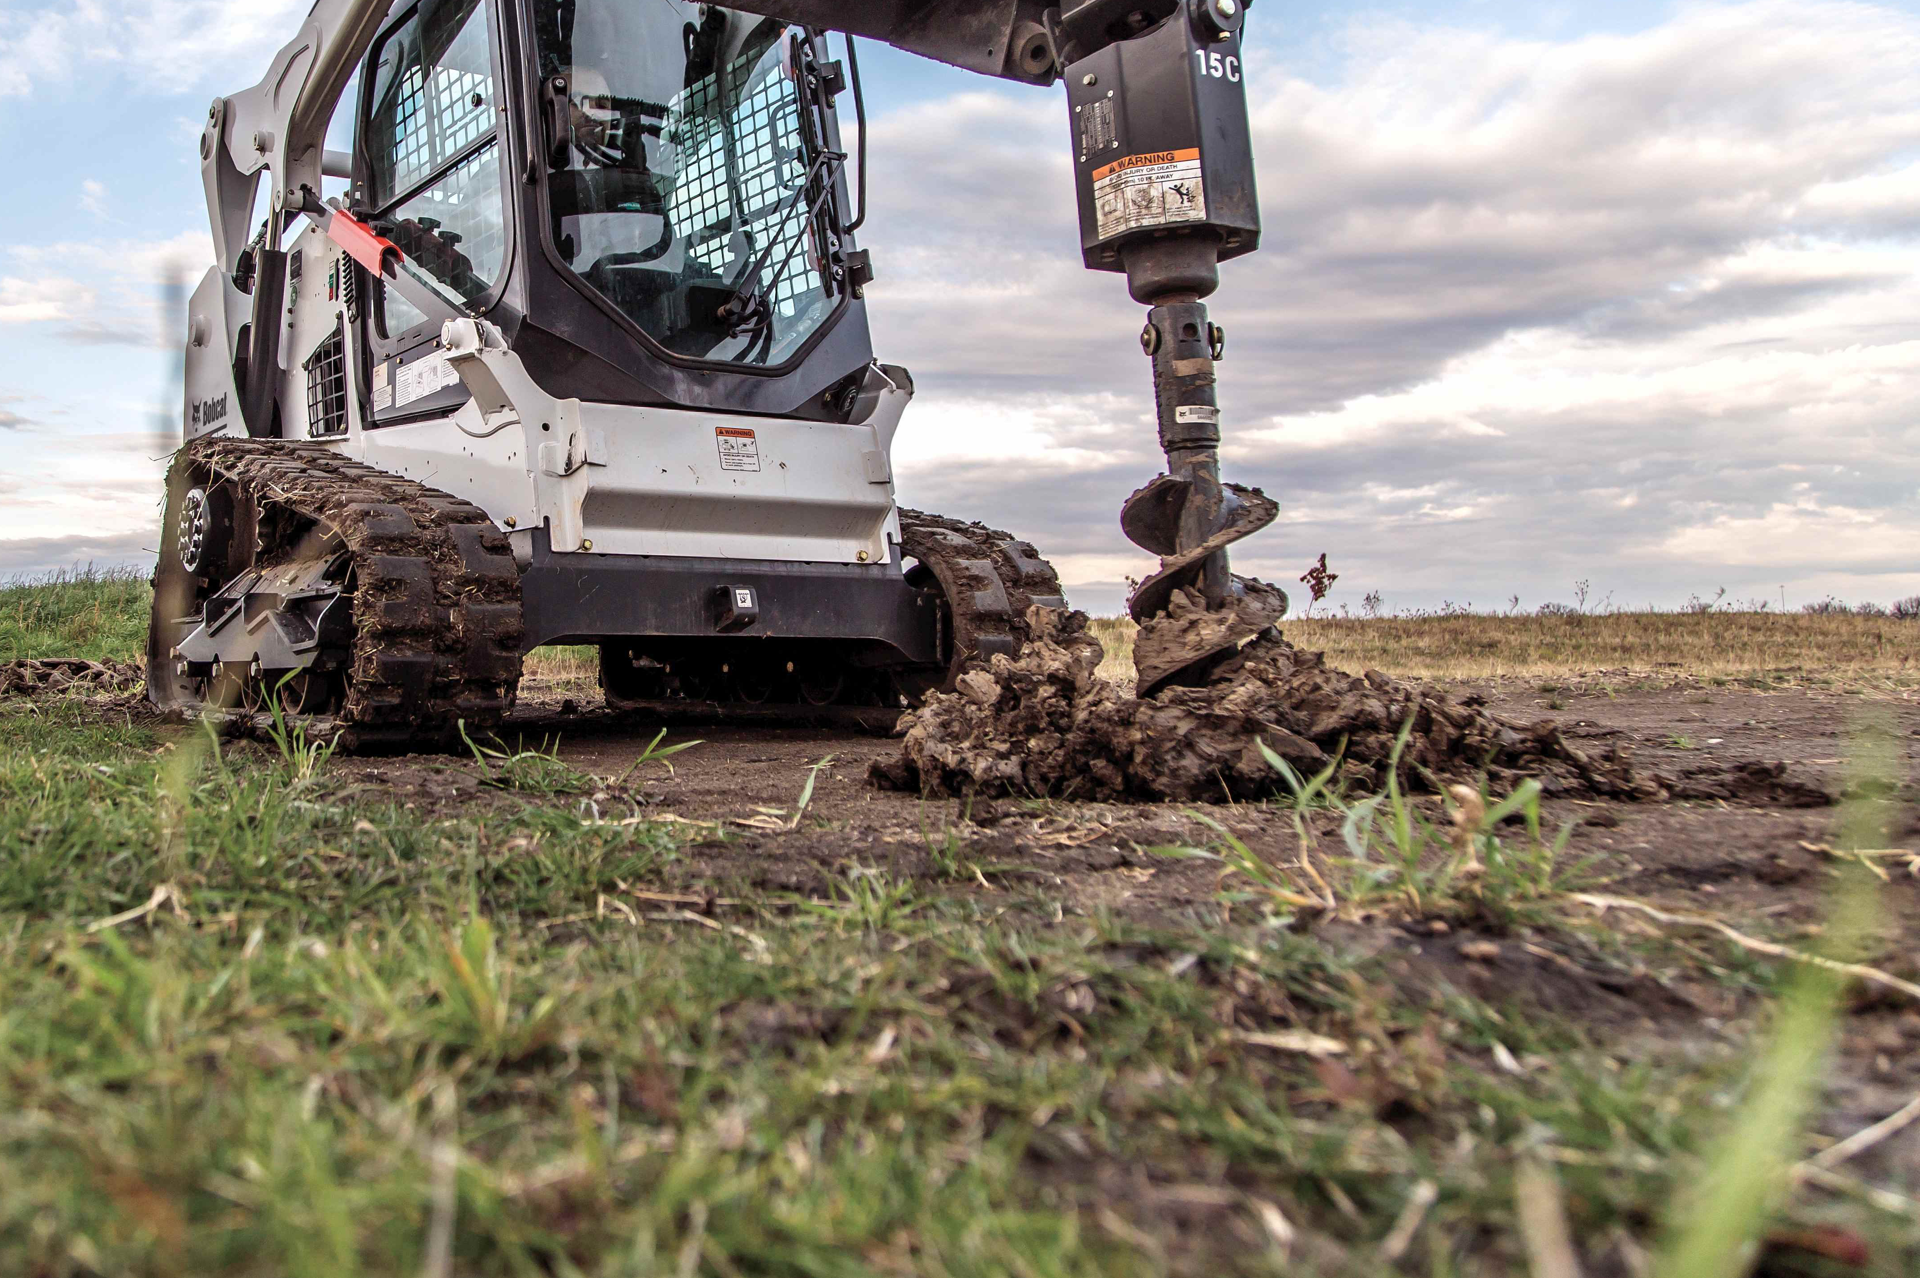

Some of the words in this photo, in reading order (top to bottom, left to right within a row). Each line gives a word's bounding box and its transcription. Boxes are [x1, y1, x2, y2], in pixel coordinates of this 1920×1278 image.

[1195, 49, 1240, 82] 15C
[1117, 152, 1175, 169] WARNING
[1122, 168, 1144, 177] INJURY
[1157, 164, 1178, 172] DEATH
[203, 391, 226, 426] Bobcat
